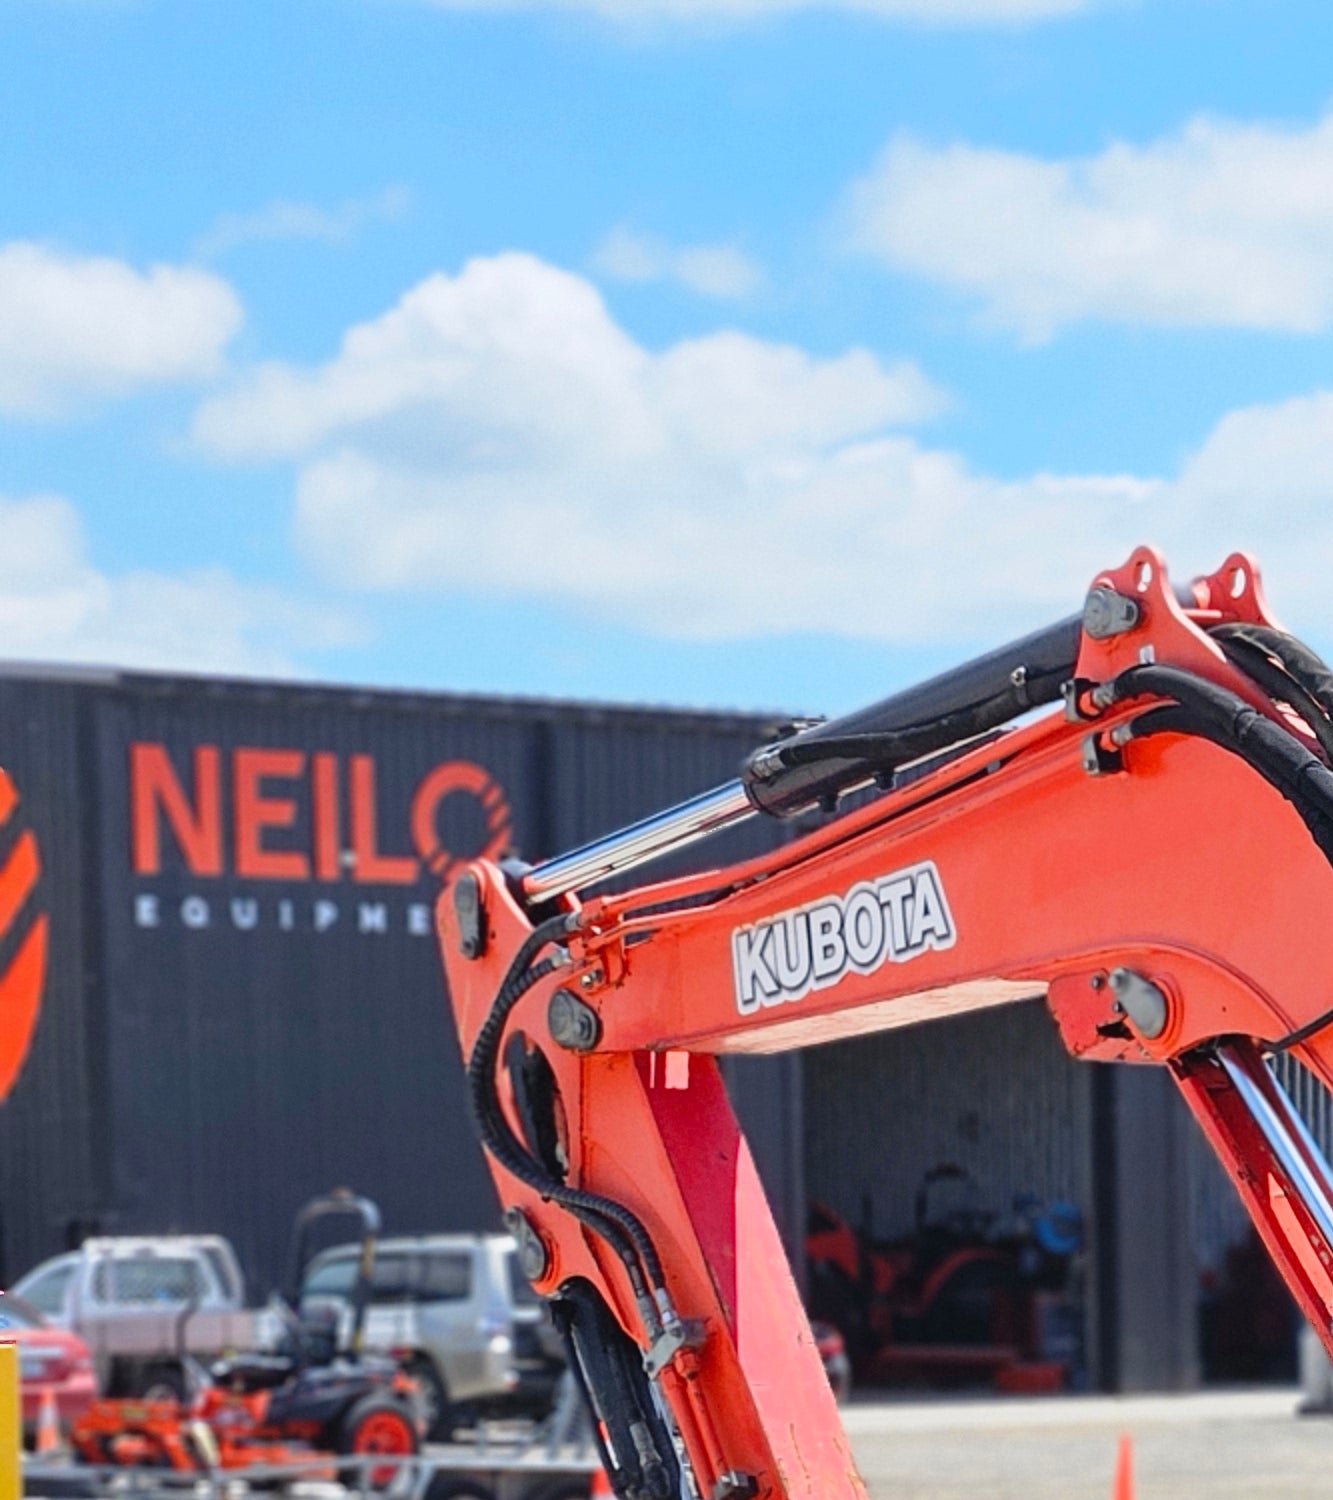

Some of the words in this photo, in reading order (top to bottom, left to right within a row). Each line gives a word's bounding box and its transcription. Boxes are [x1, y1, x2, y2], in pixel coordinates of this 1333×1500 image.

[130, 741, 511, 884] NEILO
[134, 894, 433, 935] EQUIPME
[735, 868, 952, 1005] KUBOTA
